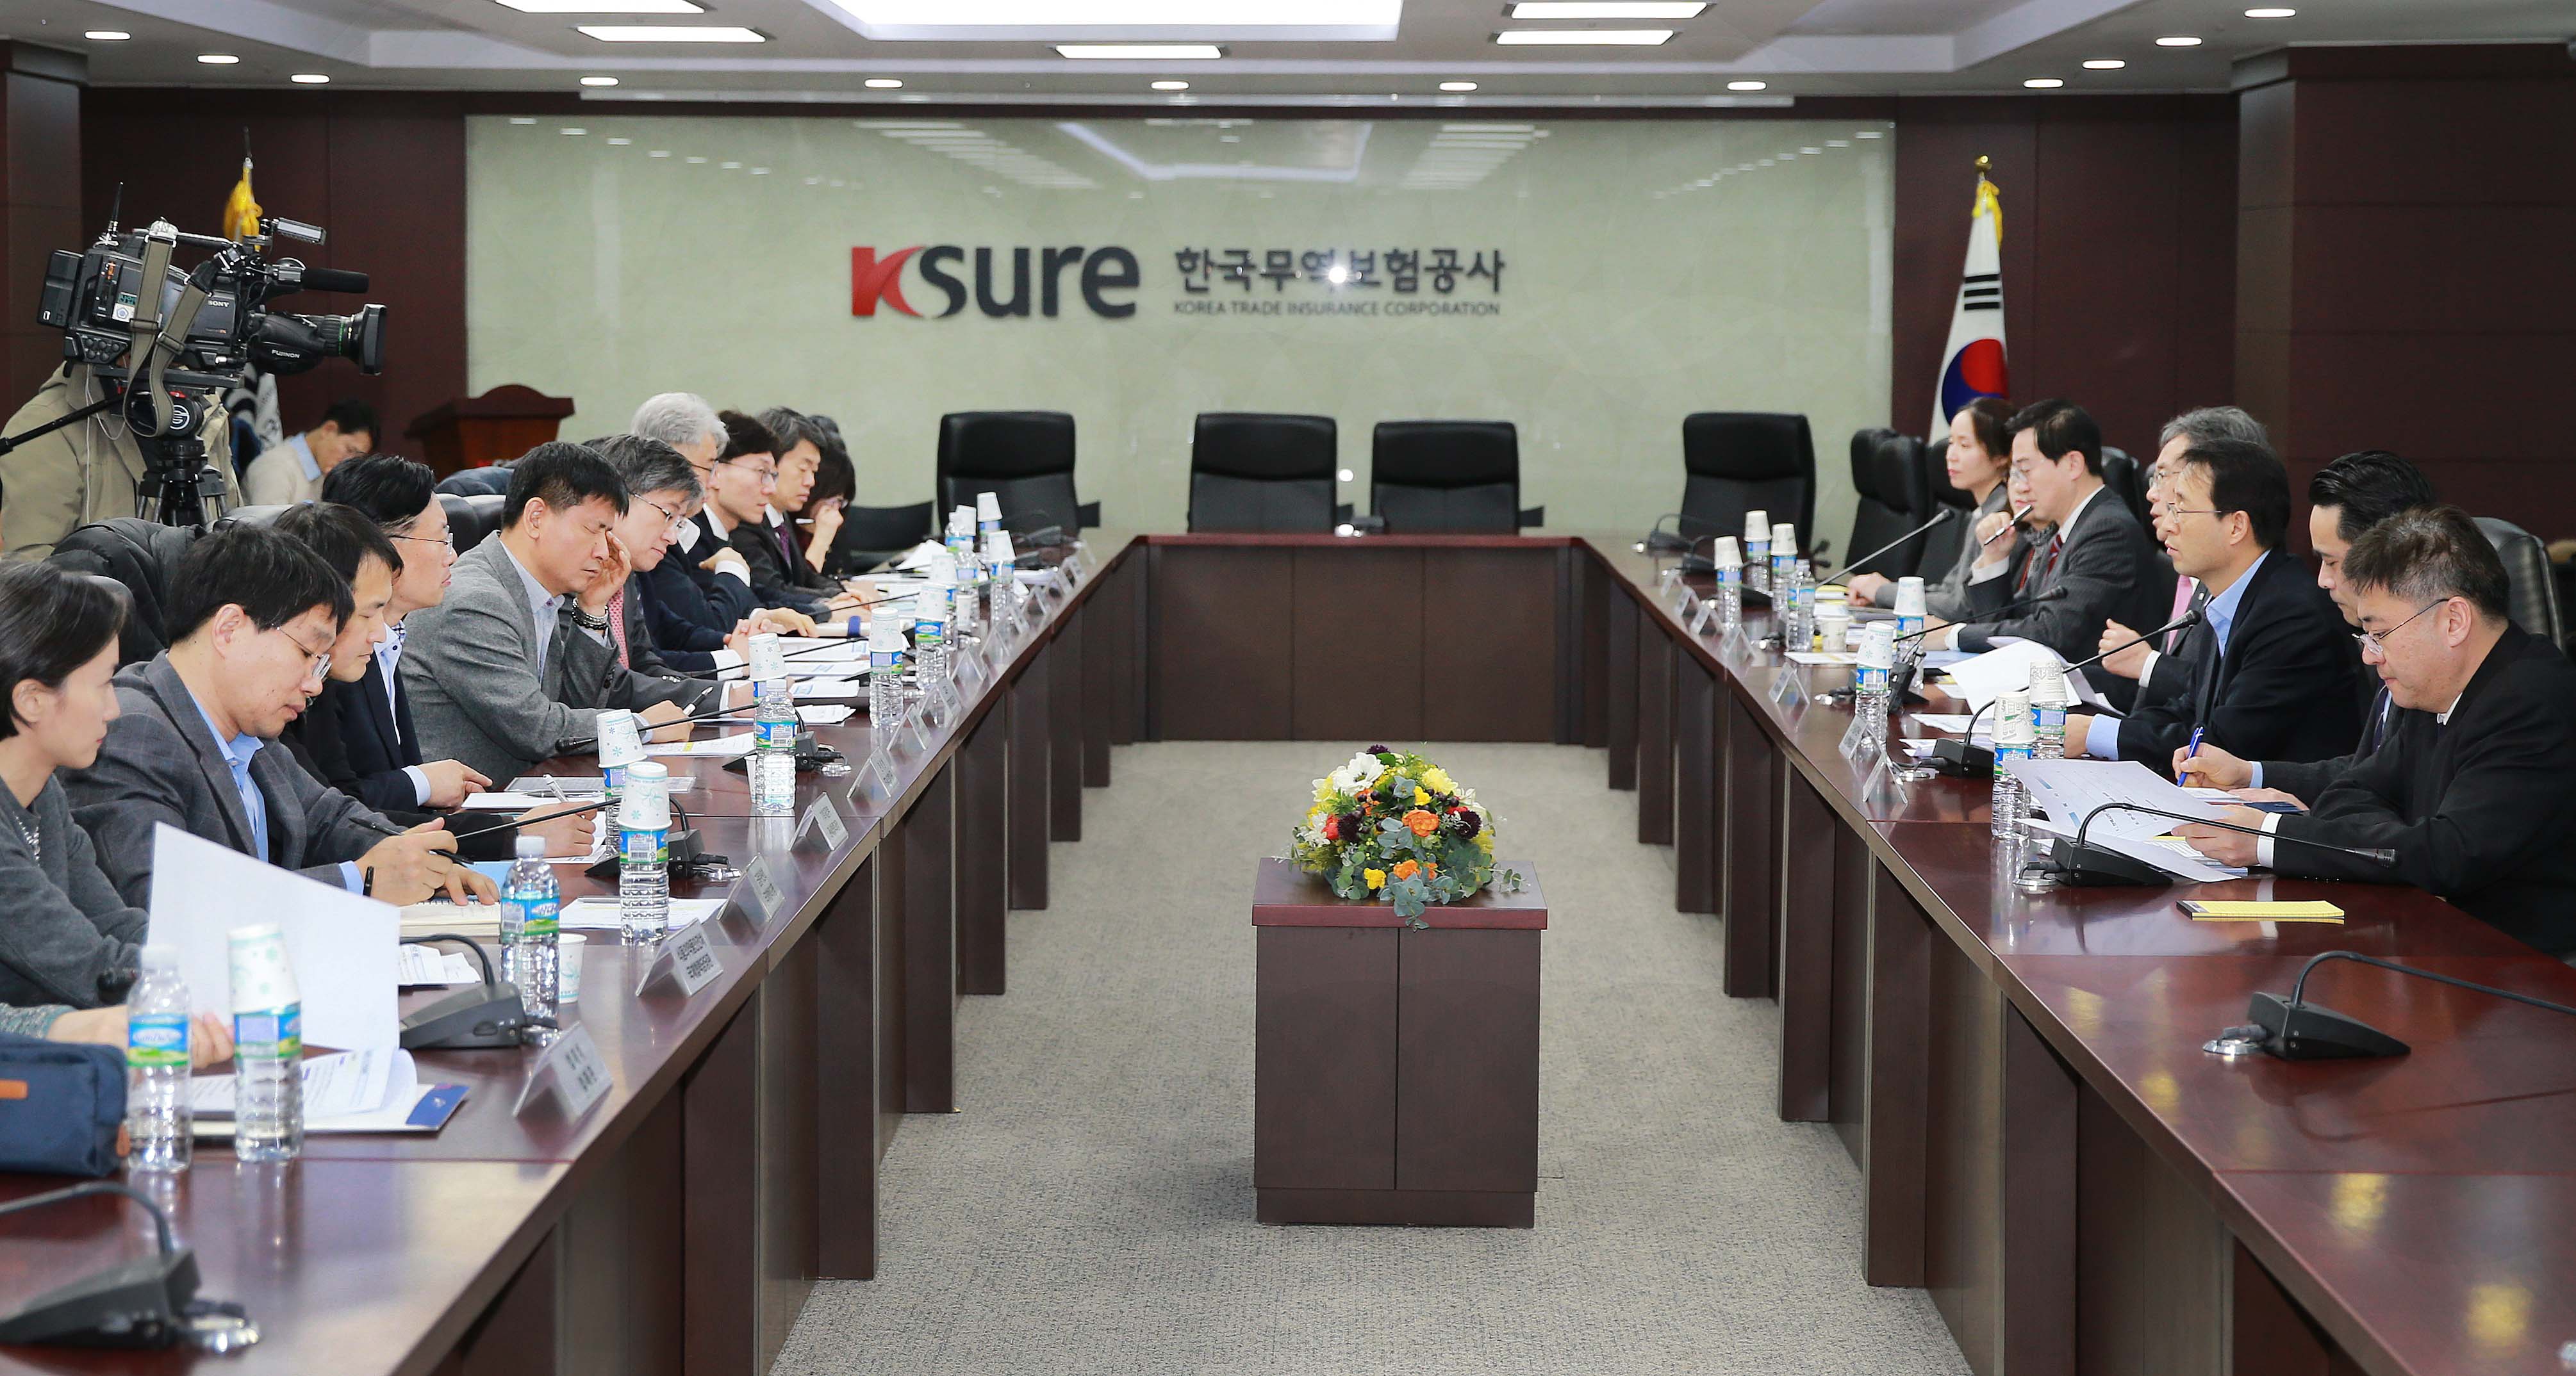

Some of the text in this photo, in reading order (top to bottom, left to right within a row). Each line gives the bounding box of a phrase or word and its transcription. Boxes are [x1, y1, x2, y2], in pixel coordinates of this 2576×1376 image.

[1175, 247, 1505, 294] 한국무역보험공사
[1174, 302, 1500, 315] KOREA TRADE INSURANCE CORPORATION
[272, 349, 301, 359] FUJINON
